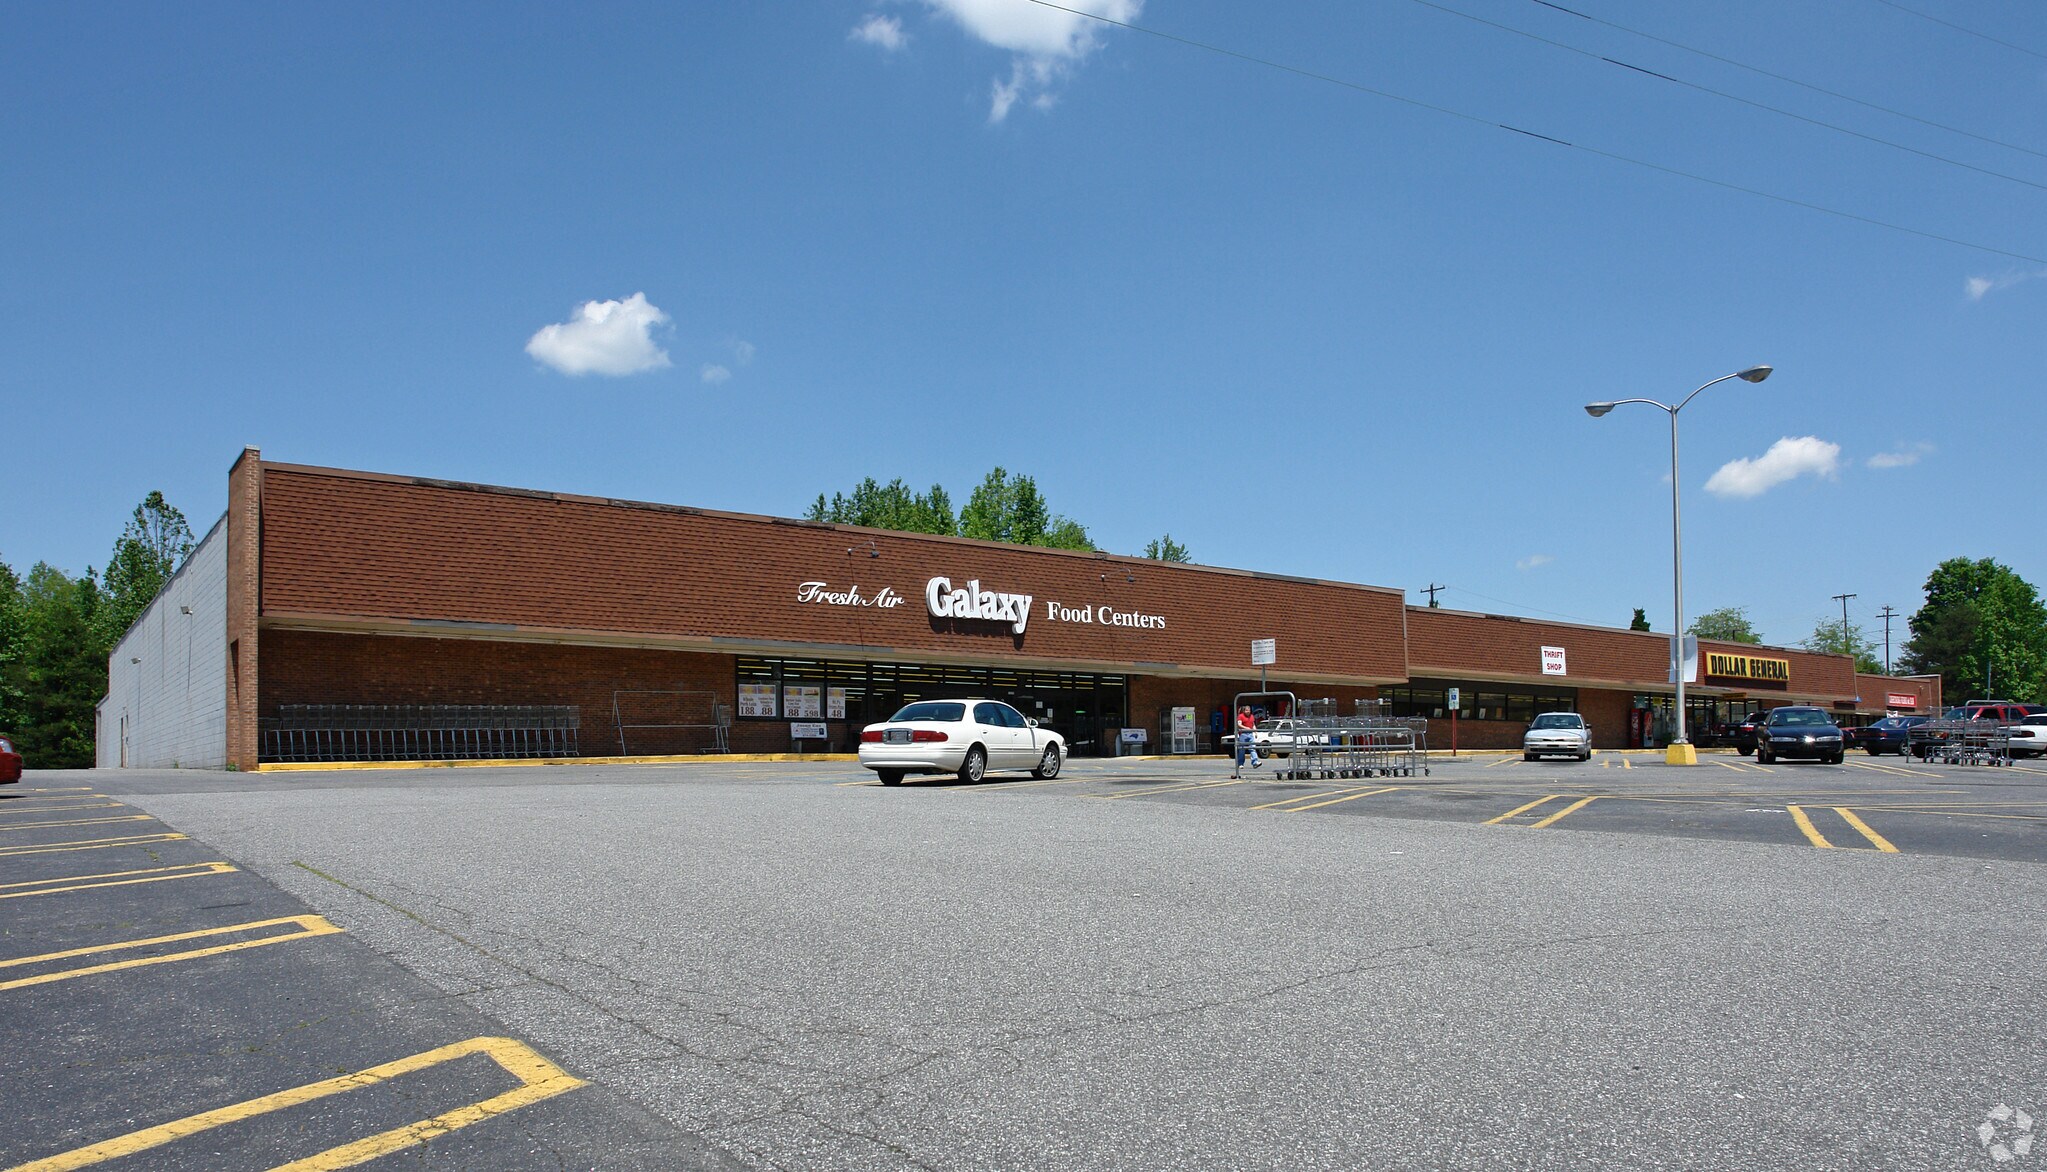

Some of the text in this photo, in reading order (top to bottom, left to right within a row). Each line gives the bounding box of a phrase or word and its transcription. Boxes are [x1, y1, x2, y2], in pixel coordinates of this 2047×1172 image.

[797, 581, 904, 609] Fresh Air
[926, 576, 1033, 635] Galaxy
[1047, 601, 1166, 629] Food Centers
[1544, 650, 1563, 659] THRIFT
[1547, 662, 1563, 671] SHOP
[1710, 654, 1788, 680] DOLLAR GENERAL
